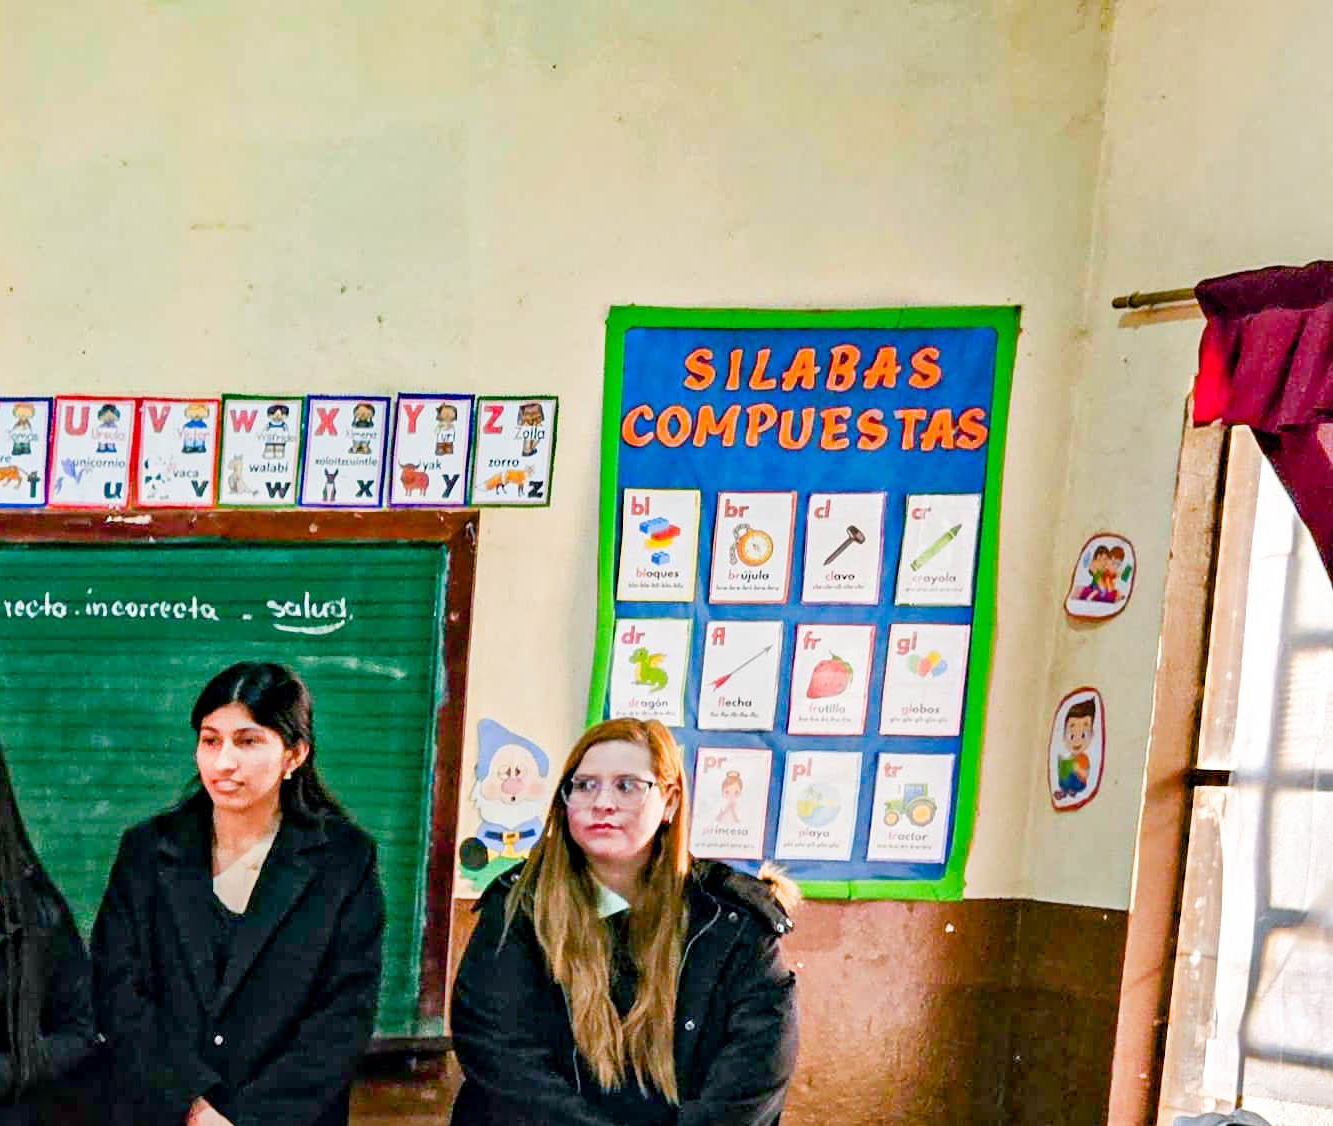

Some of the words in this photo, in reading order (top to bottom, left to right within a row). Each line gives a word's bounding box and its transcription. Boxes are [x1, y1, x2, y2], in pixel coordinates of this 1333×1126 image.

[683, 344, 942, 393] SILABAS
[64, 406, 89, 435] U
[146, 406, 170, 432] V
[230, 409, 258, 432] W
[315, 407, 338, 436] X
[403, 405, 425, 433] Y
[483, 405, 503, 433] Z
[622, 404, 989, 452] COMPUESTAS
[71, 458, 125, 468] unicornio
[249, 462, 289, 473] walabi
[488, 458, 519, 467] zorro
[631, 496, 650, 516] bl
[725, 499, 749, 518] br
[814, 500, 831, 519] cl
[636, 568, 679, 579] bloques
[728, 570, 769, 582] brújula
[825, 571, 855, 581] clavo
[621, 625, 645, 646] dr
[896, 632, 917, 655] gl
[628, 697, 669, 710] dragón
[901, 703, 940, 714] globos
[703, 755, 727, 773] pr
[791, 759, 812, 782] pl
[798, 829, 830, 840] playa
